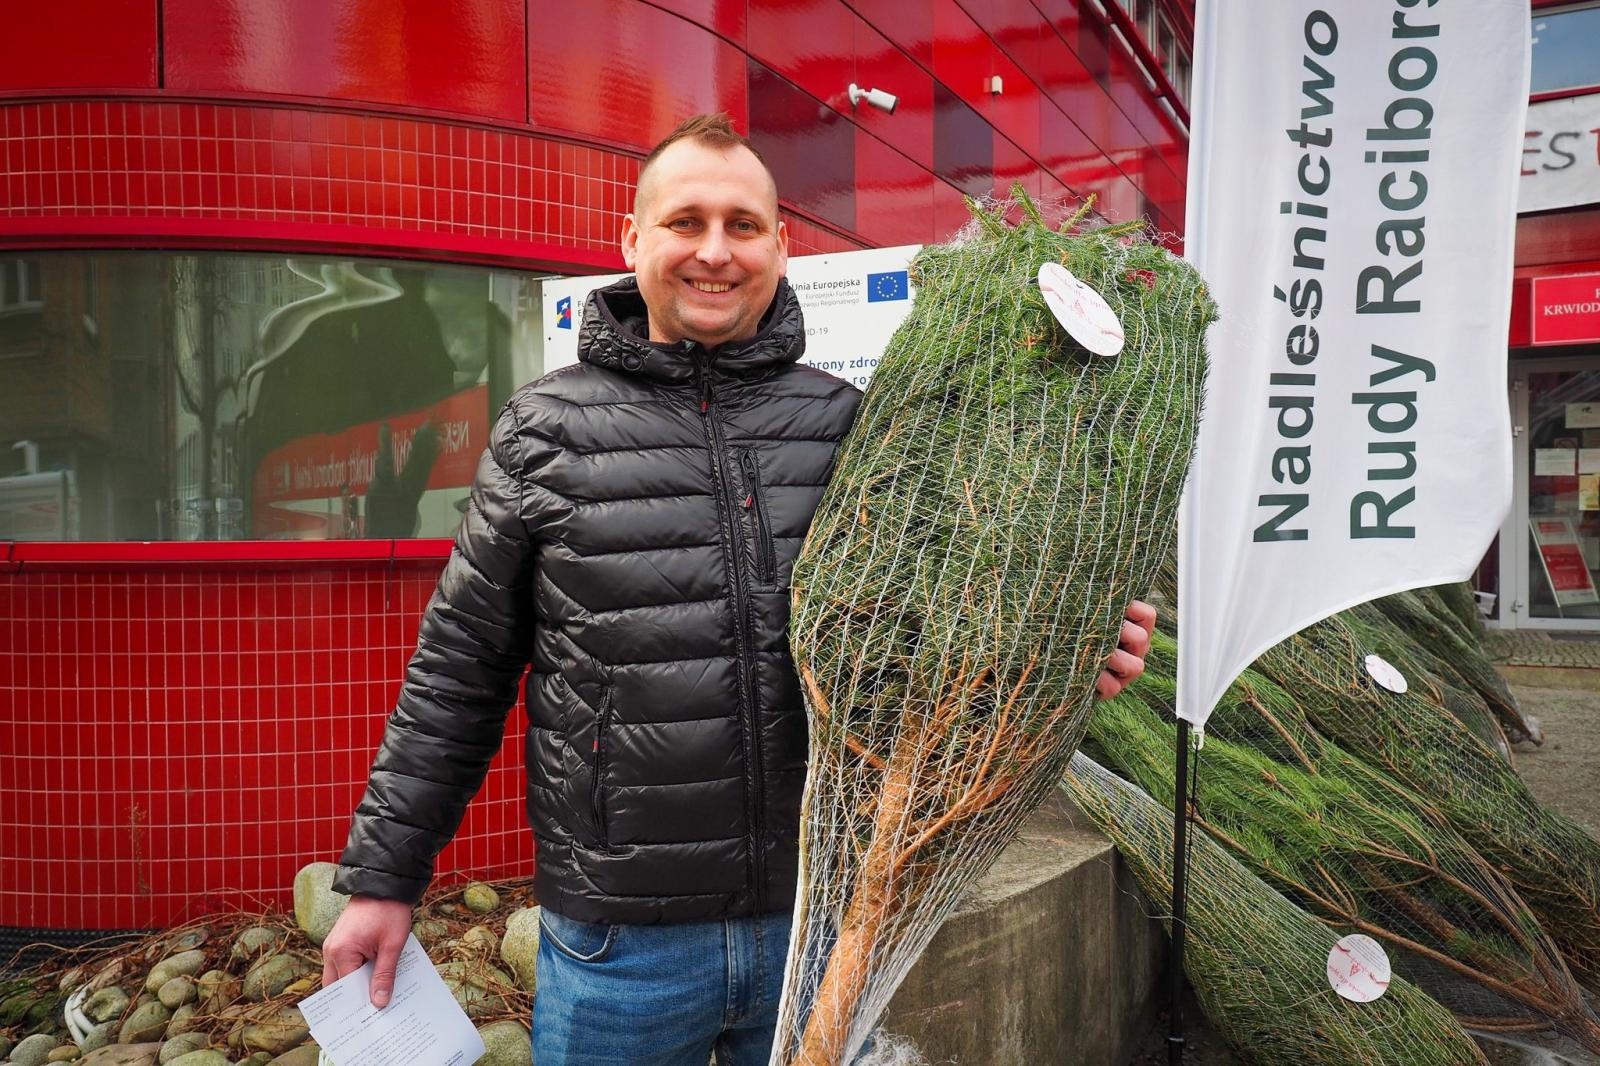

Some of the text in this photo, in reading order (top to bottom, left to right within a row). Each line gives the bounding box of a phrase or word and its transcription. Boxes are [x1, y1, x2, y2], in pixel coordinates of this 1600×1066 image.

[805, 359, 845, 371] hrony
[812, 278, 861, 290] Europejska
[1253, 9, 1339, 542] Nadleśnictwo
[1350, 0, 1441, 540] Rudy Racibor
